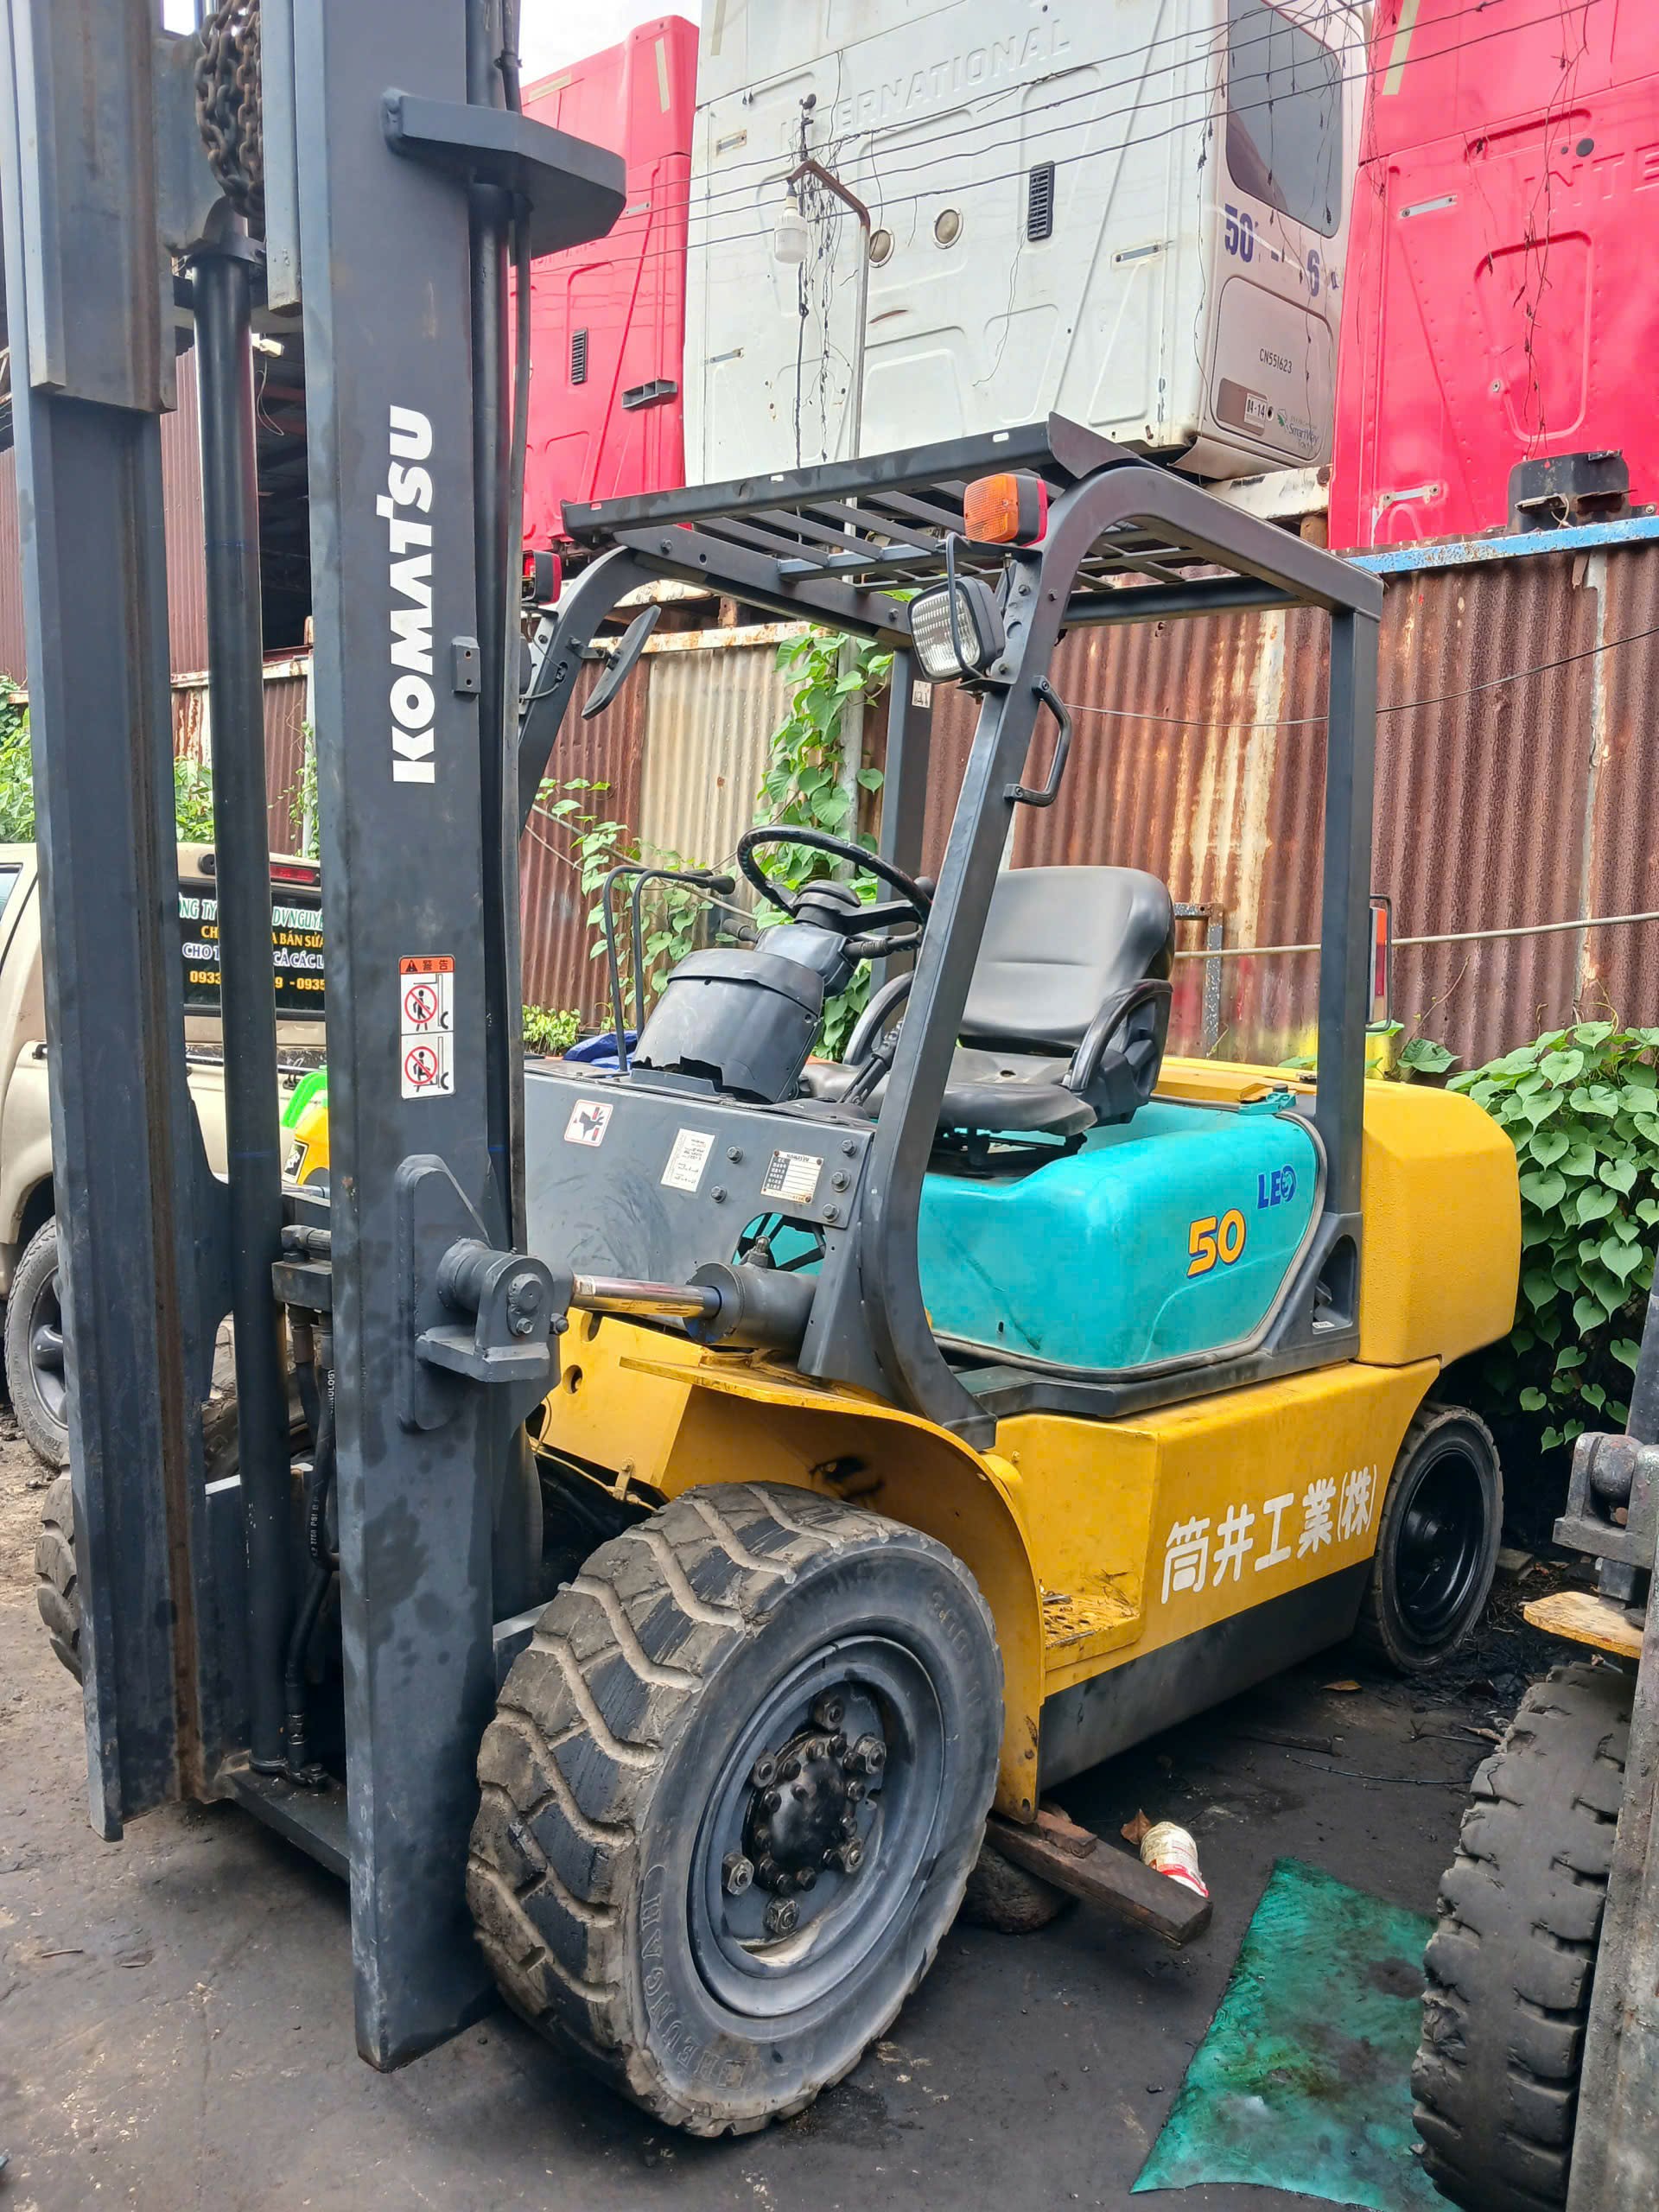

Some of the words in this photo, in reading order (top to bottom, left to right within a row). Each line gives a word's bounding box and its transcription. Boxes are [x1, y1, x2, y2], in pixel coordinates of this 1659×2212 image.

[1259, 347, 1293, 374] CN551623
[377, 404, 435, 785] KOMATSU
[178, 892, 200, 920] NG
[182, 942, 213, 960] CHO
[279, 930, 302, 947] BÁN
[1257, 1165, 1297, 1210] LEO
[1186, 1208, 1246, 1279] 50
